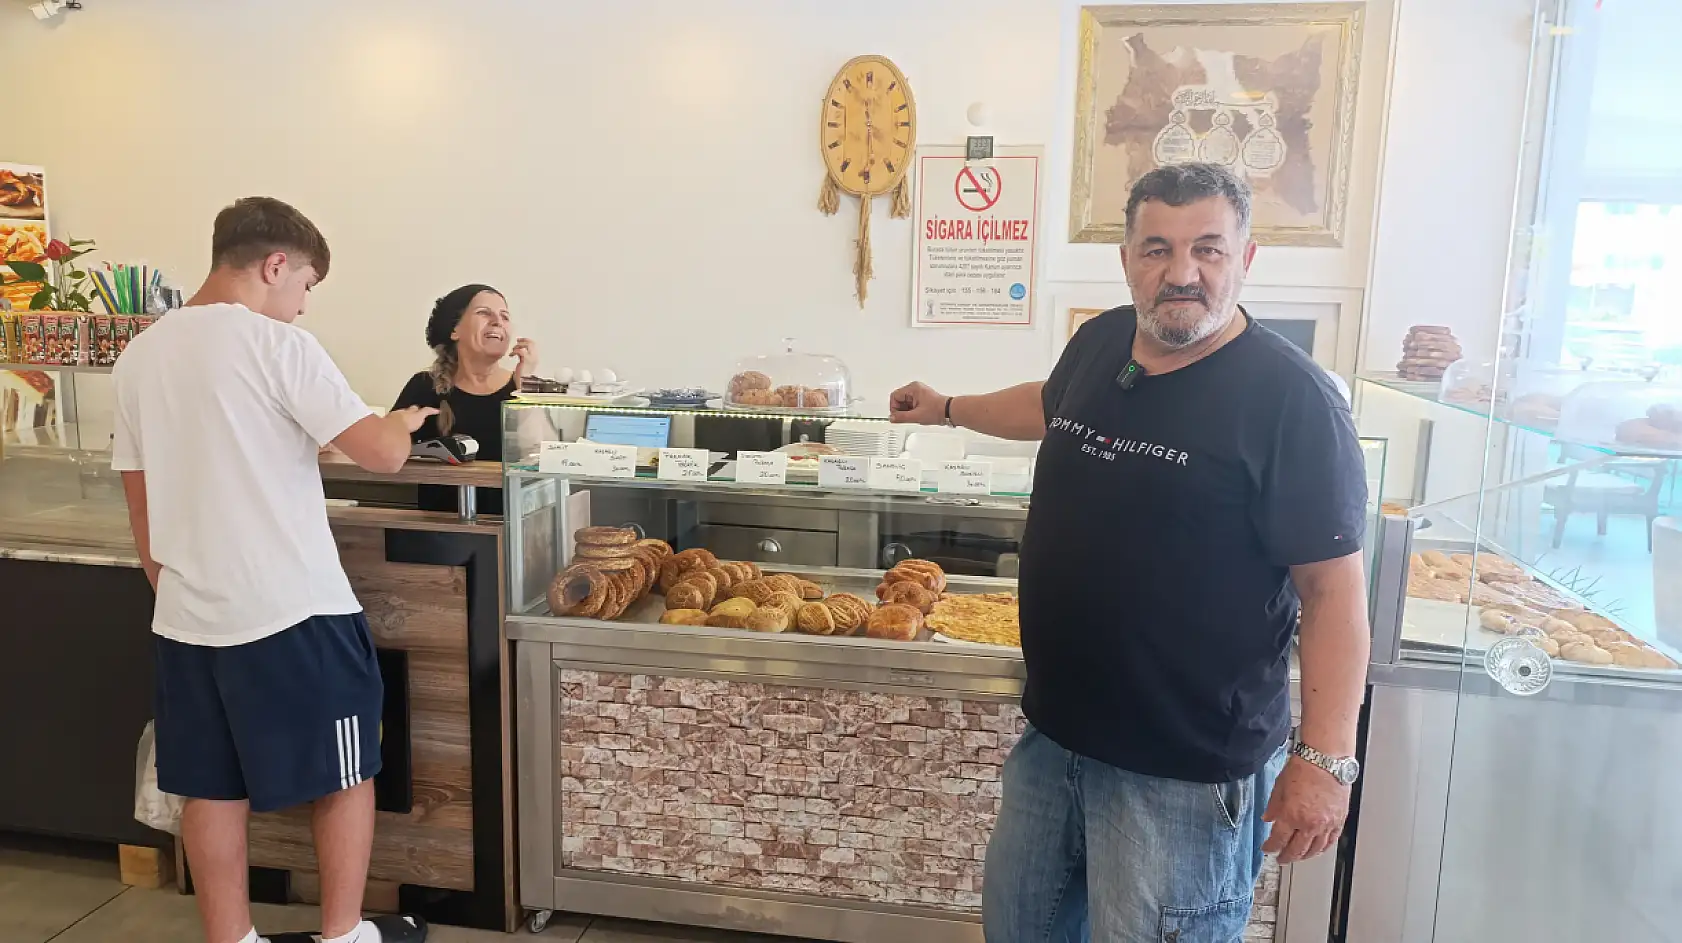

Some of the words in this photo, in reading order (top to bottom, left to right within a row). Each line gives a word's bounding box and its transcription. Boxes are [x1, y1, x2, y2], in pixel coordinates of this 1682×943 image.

[926, 214, 973, 240] SİGARA
[977, 214, 1029, 246] İÇİLMEZ
[1049, 417, 1096, 439] TOMMY
[1112, 437, 1189, 467] HILFIGER
